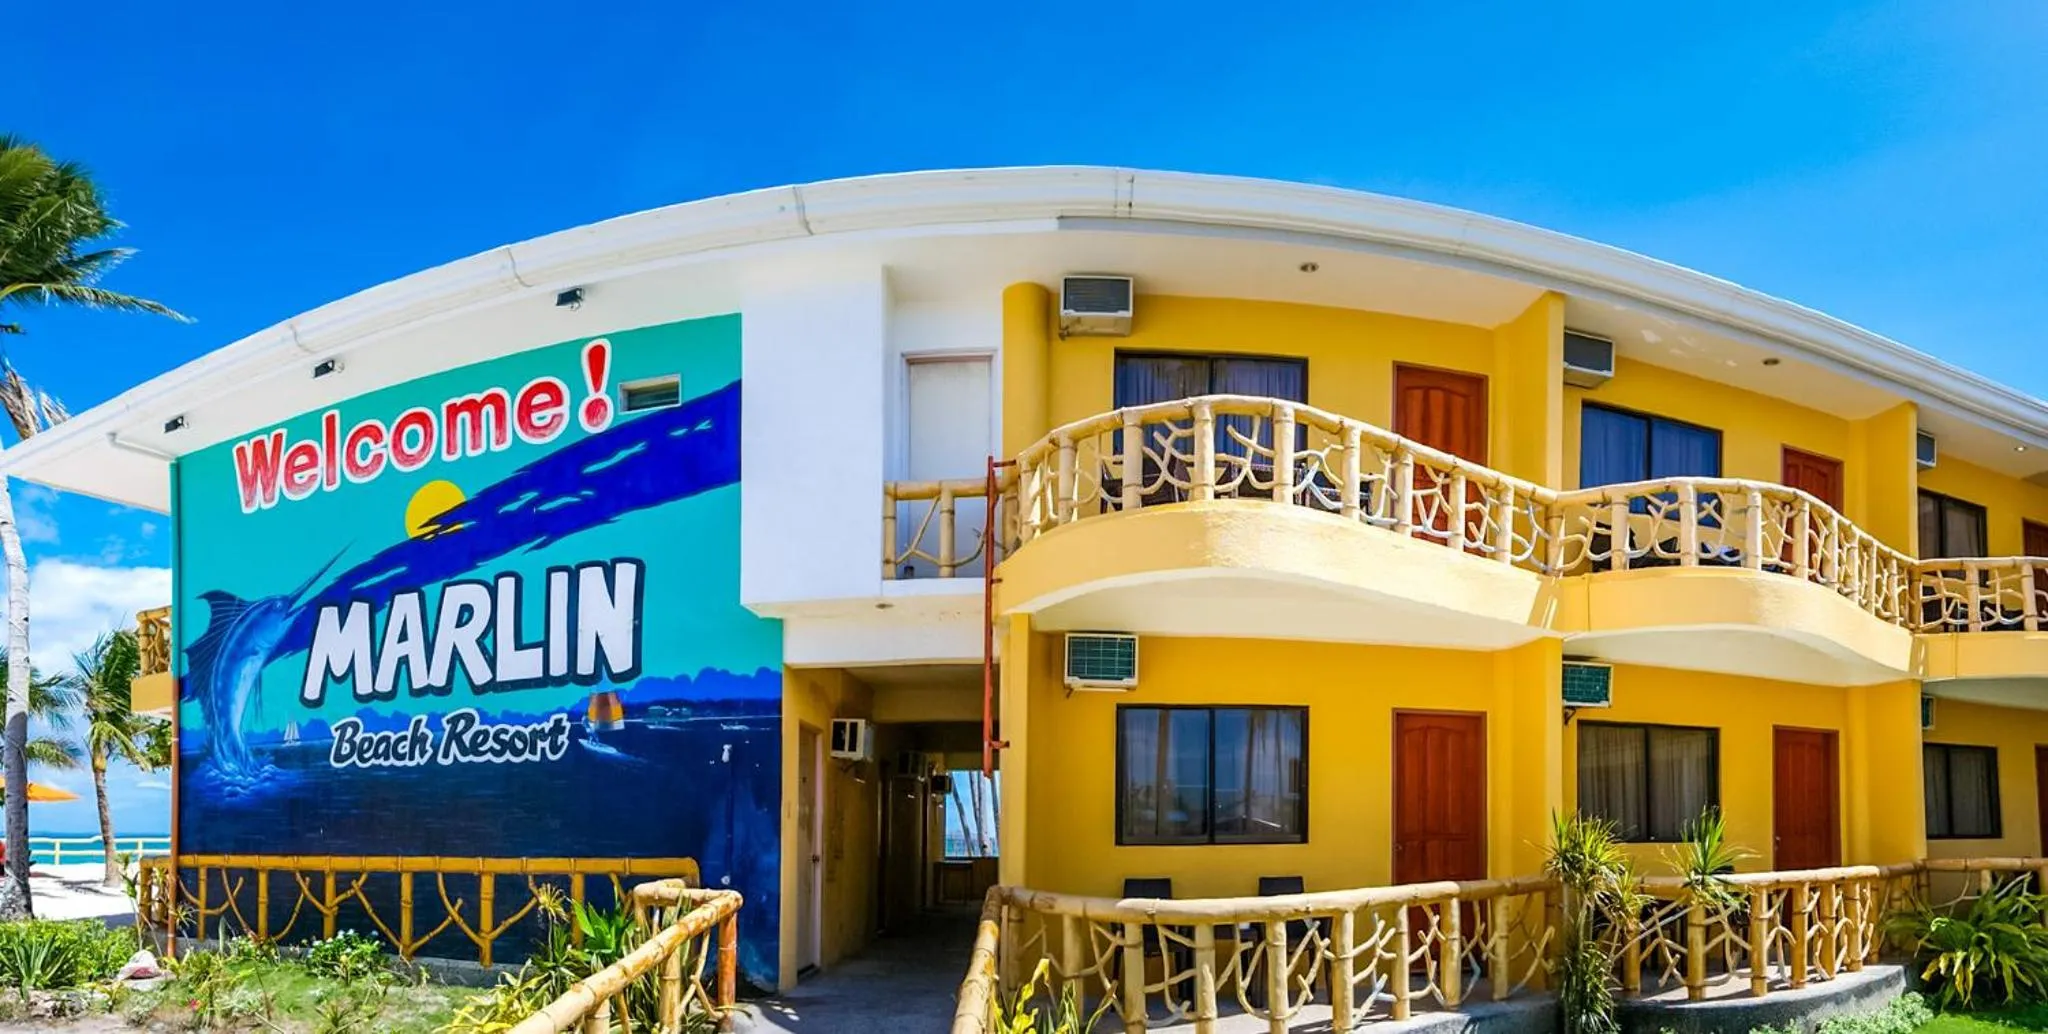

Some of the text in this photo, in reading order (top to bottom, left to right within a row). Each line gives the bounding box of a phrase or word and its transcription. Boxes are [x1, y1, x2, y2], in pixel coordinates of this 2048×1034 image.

[233, 340, 612, 512] Welcome!
[301, 558, 645, 706] MARLIN
[330, 709, 569, 768] Beach Resort
